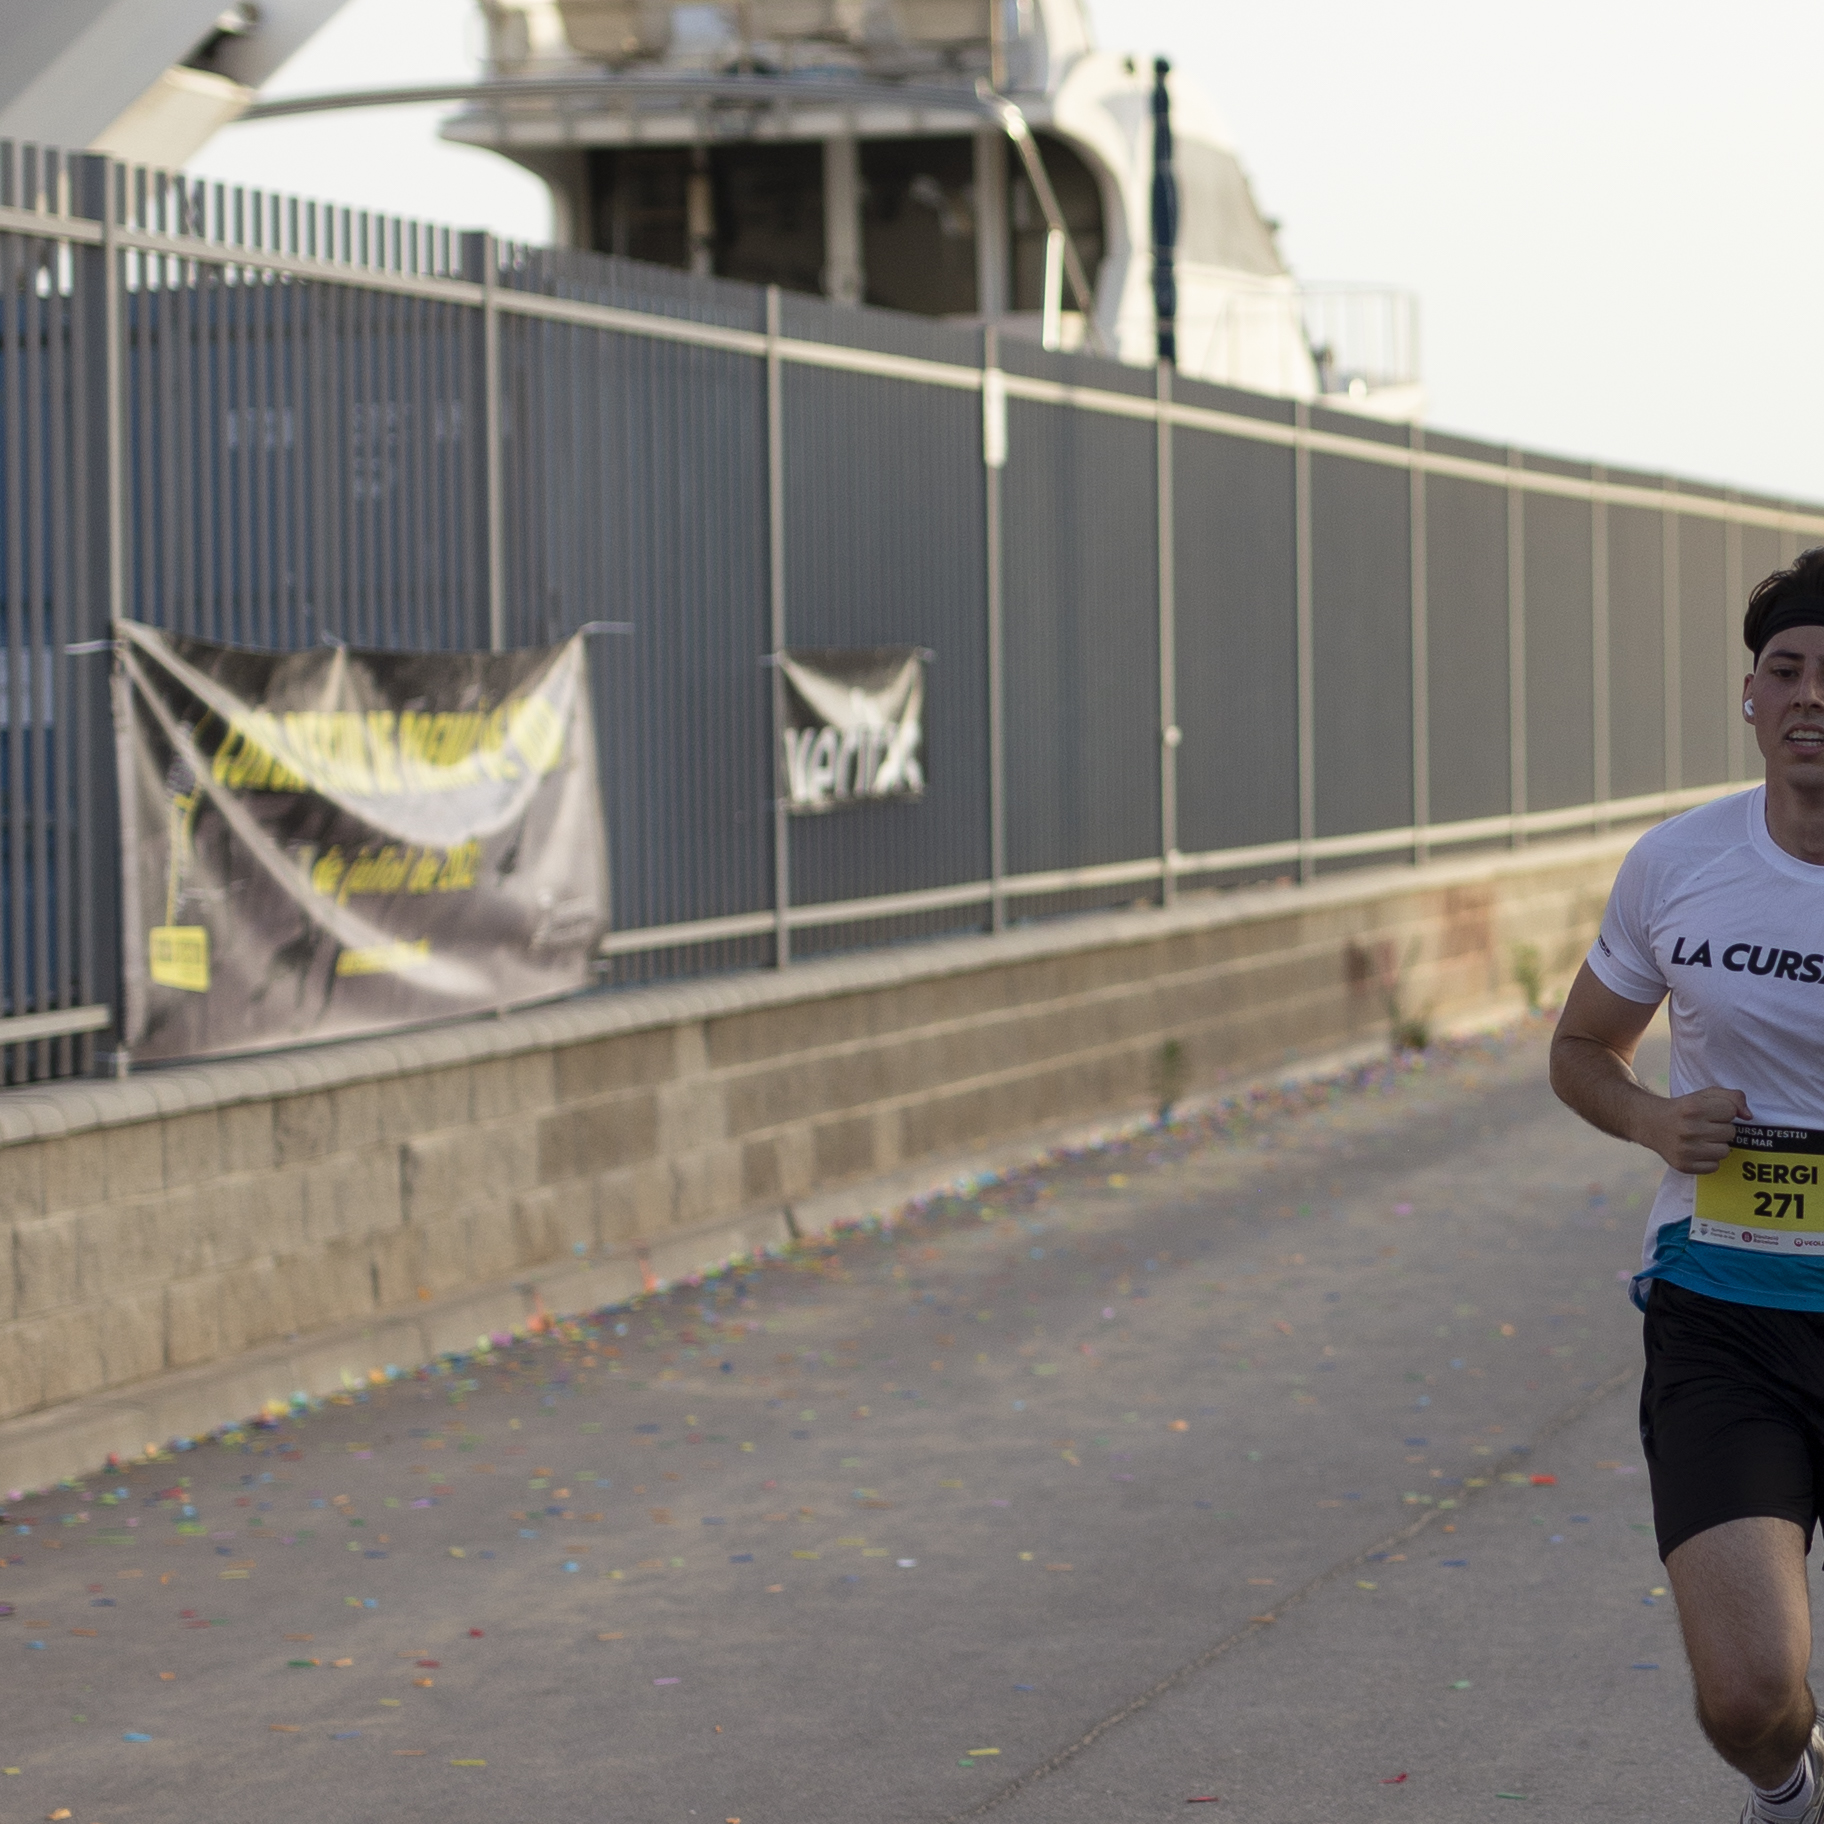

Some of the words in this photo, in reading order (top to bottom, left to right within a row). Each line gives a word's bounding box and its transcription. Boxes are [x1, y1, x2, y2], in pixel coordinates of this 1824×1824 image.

[1671, 937, 1712, 968] LA
[1735, 1126, 1764, 1136] URSA
[1766, 1129, 1808, 1139] D'ESTIU
[1736, 1136, 1749, 1145] DE
[1751, 1138, 1774, 1148] MAR
[1742, 1161, 1818, 1185] SERGI
[1753, 1191, 1805, 1220] 271
